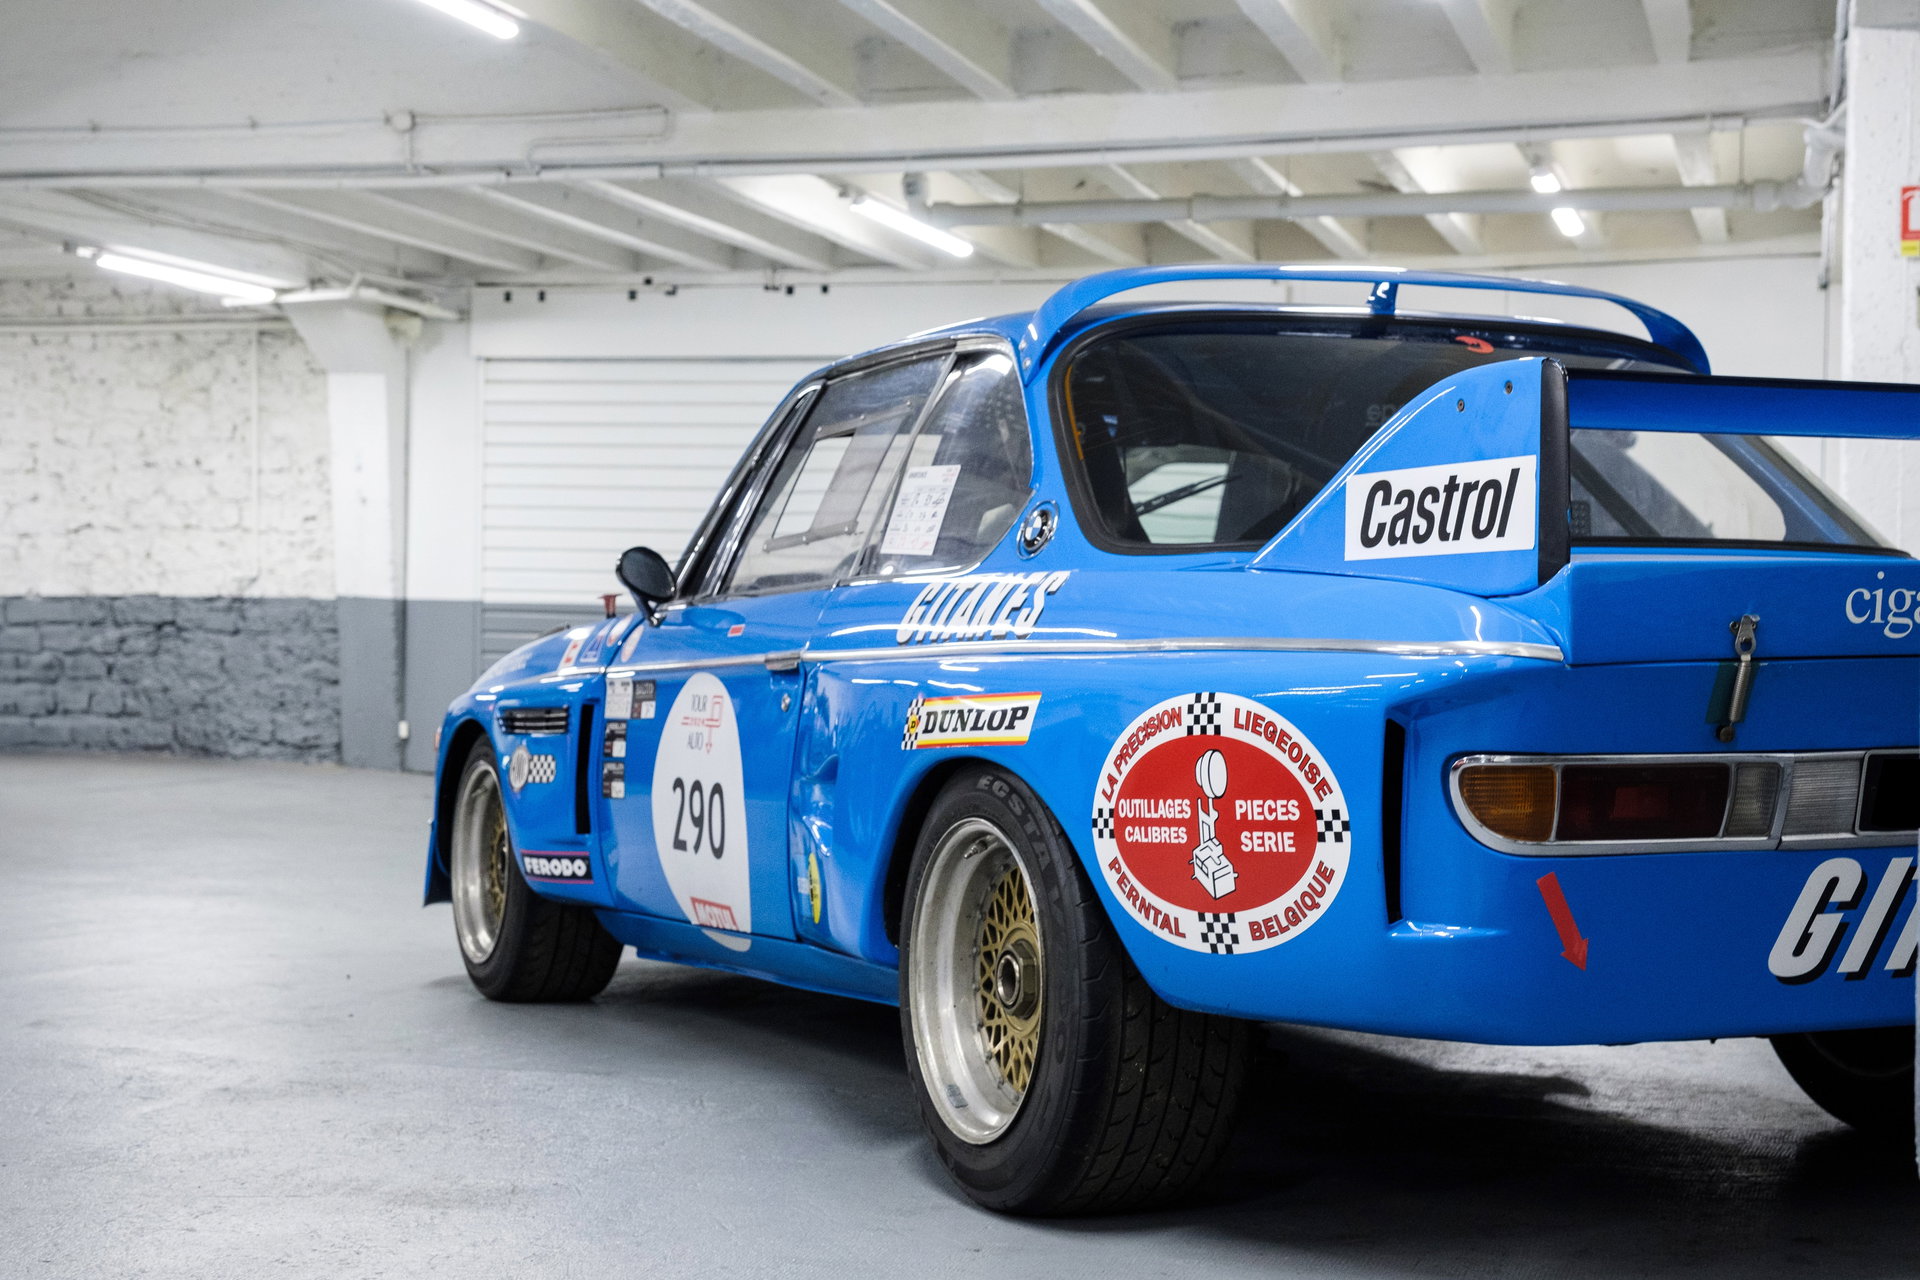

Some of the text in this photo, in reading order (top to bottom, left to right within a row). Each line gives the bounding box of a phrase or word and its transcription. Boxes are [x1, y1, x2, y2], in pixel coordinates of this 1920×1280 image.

[1360, 467, 1521, 549] Castrol
[896, 571, 1071, 645] GITANES
[922, 706, 1029, 735] DUNLOP
[1101, 706, 1334, 803] LA PRECISION LIEGEOISE
[672, 777, 725, 860] 290
[976, 774, 1051, 872] ECSTA
[1118, 798, 1191, 819] OUTILLAGES
[1235, 799, 1300, 821] PIECES
[1125, 826, 1187, 844] CALIBRES
[1240, 831, 1296, 853] SERIE
[523, 856, 587, 877] FERODO
[1108, 856, 1336, 942] PERNTAL BELGIQUE
